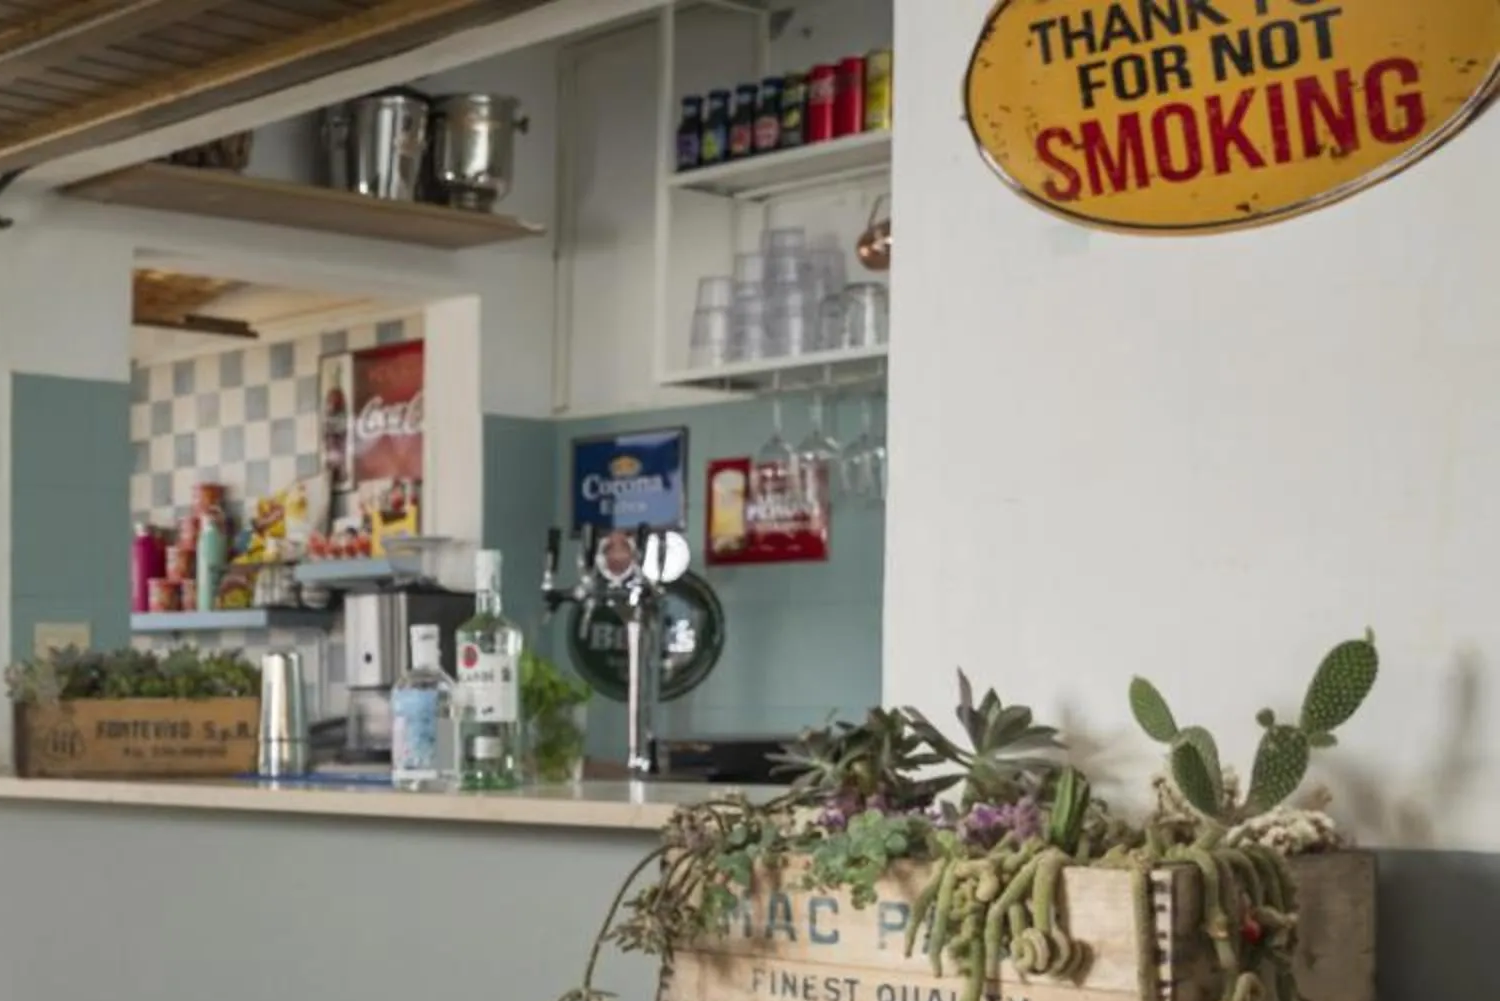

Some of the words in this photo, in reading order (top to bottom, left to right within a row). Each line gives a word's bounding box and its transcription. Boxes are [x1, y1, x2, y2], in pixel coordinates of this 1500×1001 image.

[1029, 0, 1231, 64] THANK
[1077, 44, 1192, 110] FOR
[1209, 7, 1343, 82] NOT
[1034, 57, 1427, 202] SMOKING
